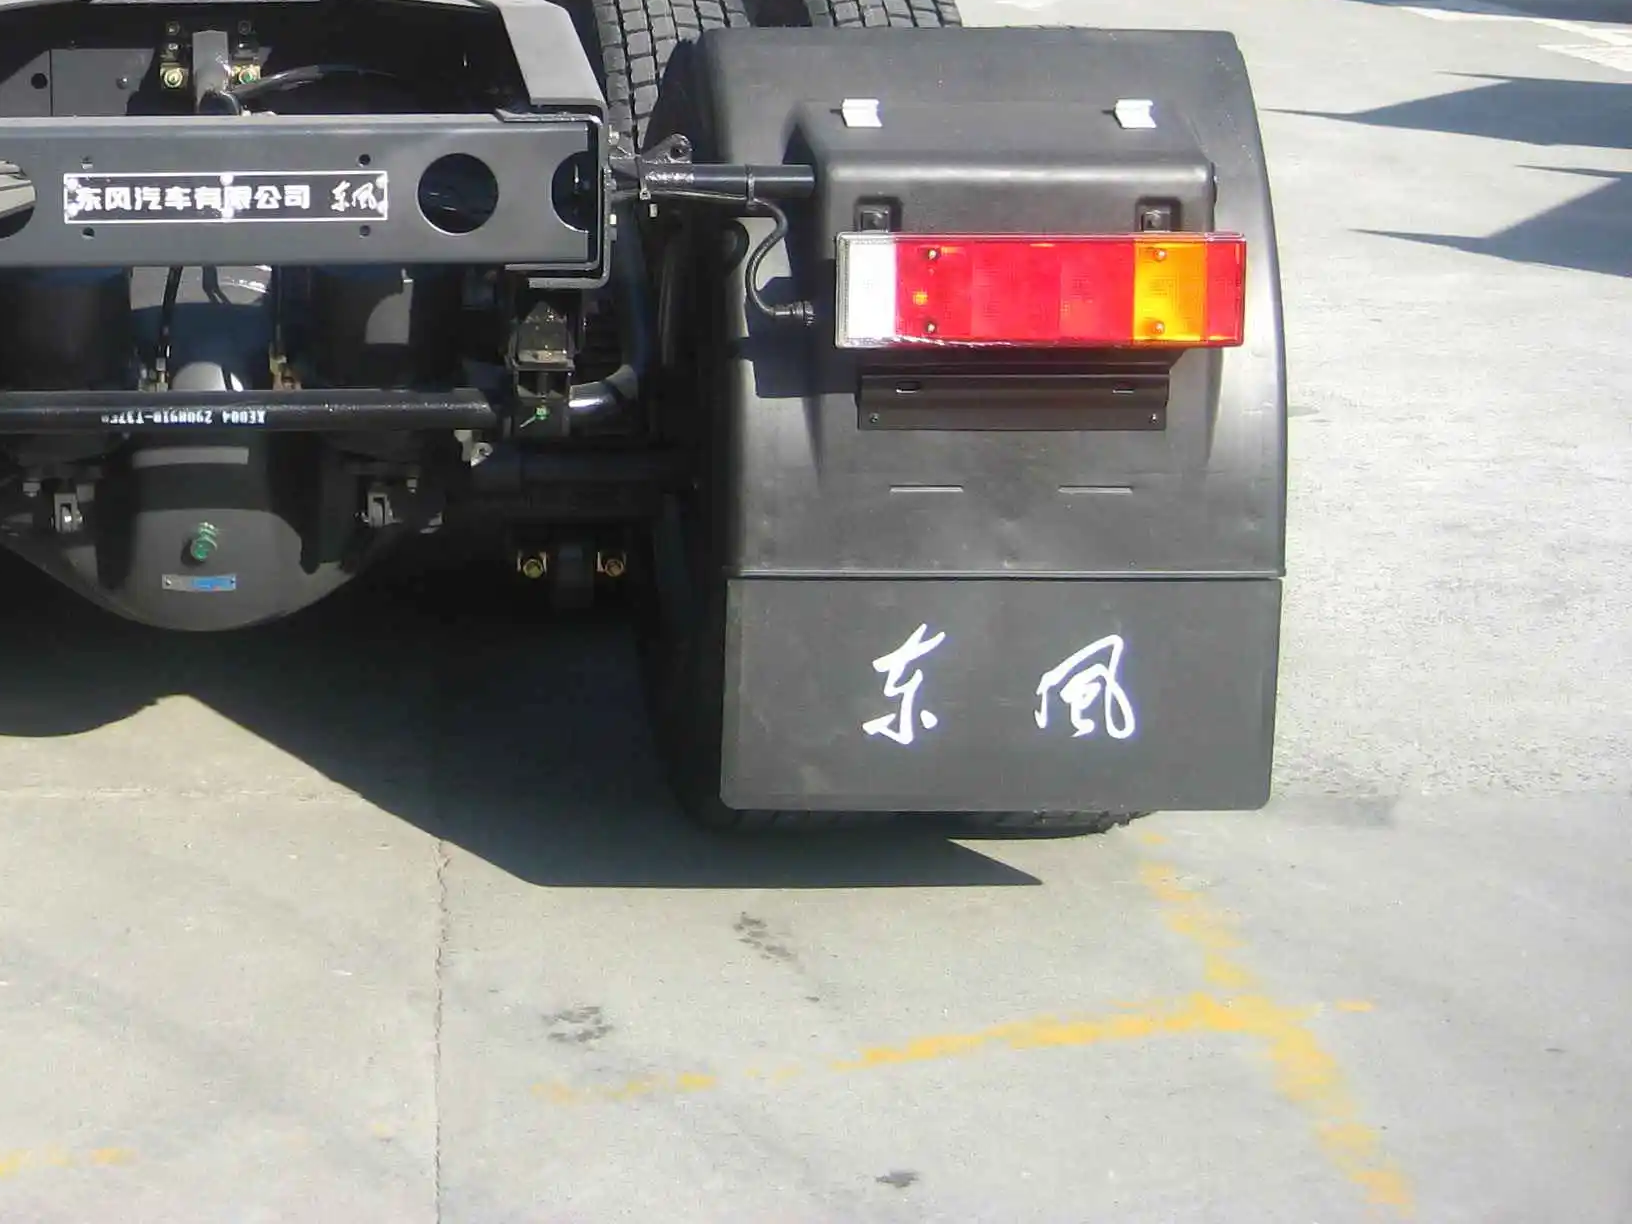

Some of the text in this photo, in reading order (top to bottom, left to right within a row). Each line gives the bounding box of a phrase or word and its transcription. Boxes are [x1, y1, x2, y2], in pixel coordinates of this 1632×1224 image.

[75, 185, 310, 212] 东风汽车有限公司
